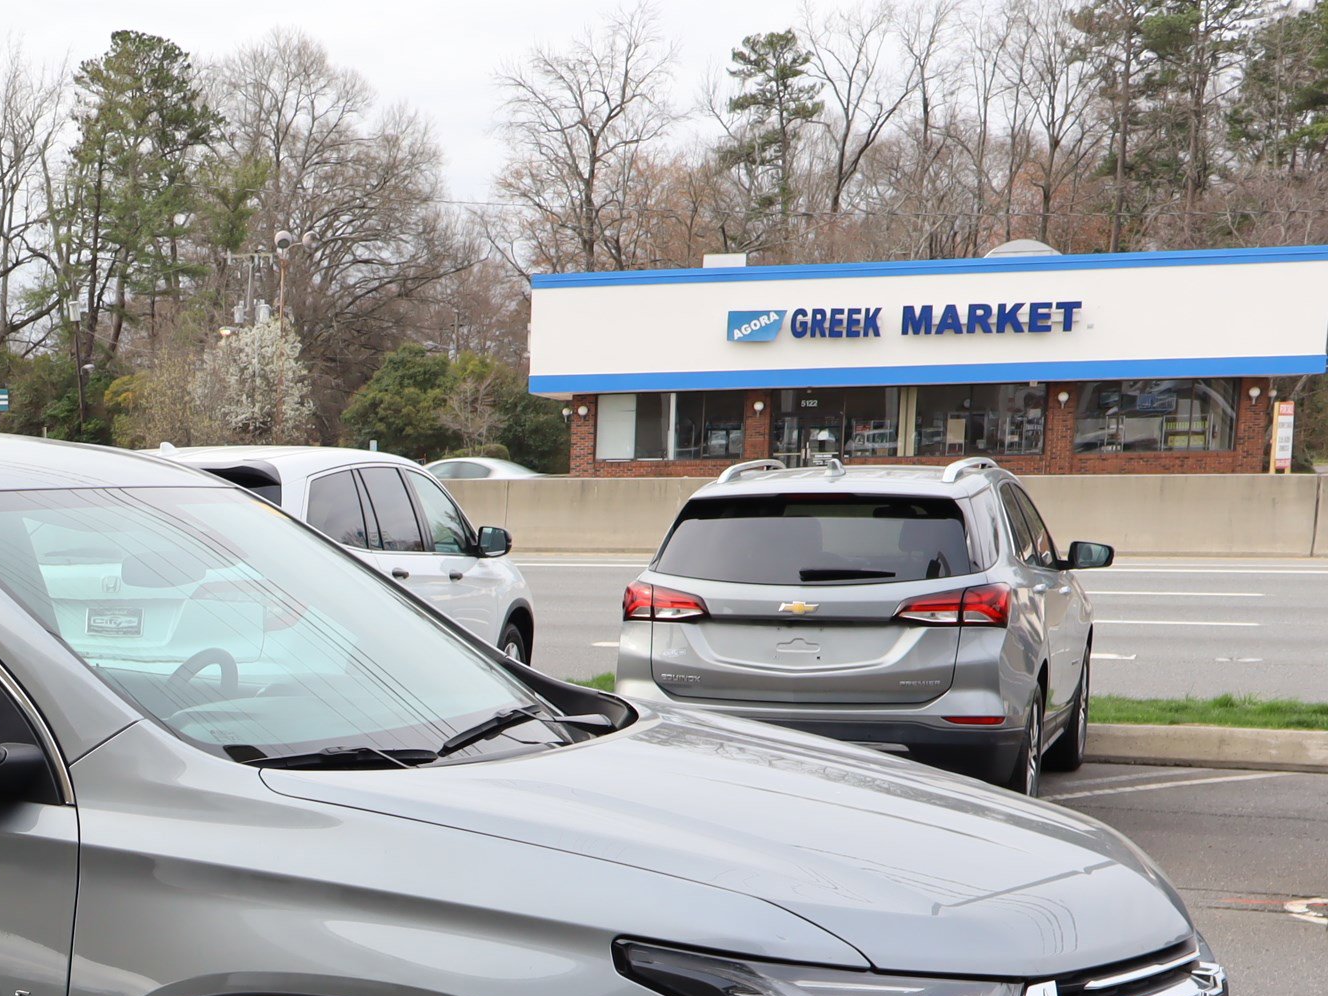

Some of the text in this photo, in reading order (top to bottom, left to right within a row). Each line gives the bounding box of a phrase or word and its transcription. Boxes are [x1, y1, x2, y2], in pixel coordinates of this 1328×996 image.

[732, 311, 780, 341] AGORA
[790, 301, 1082, 339] GREEK MARKET
[661, 673, 701, 682] EQUINOX
